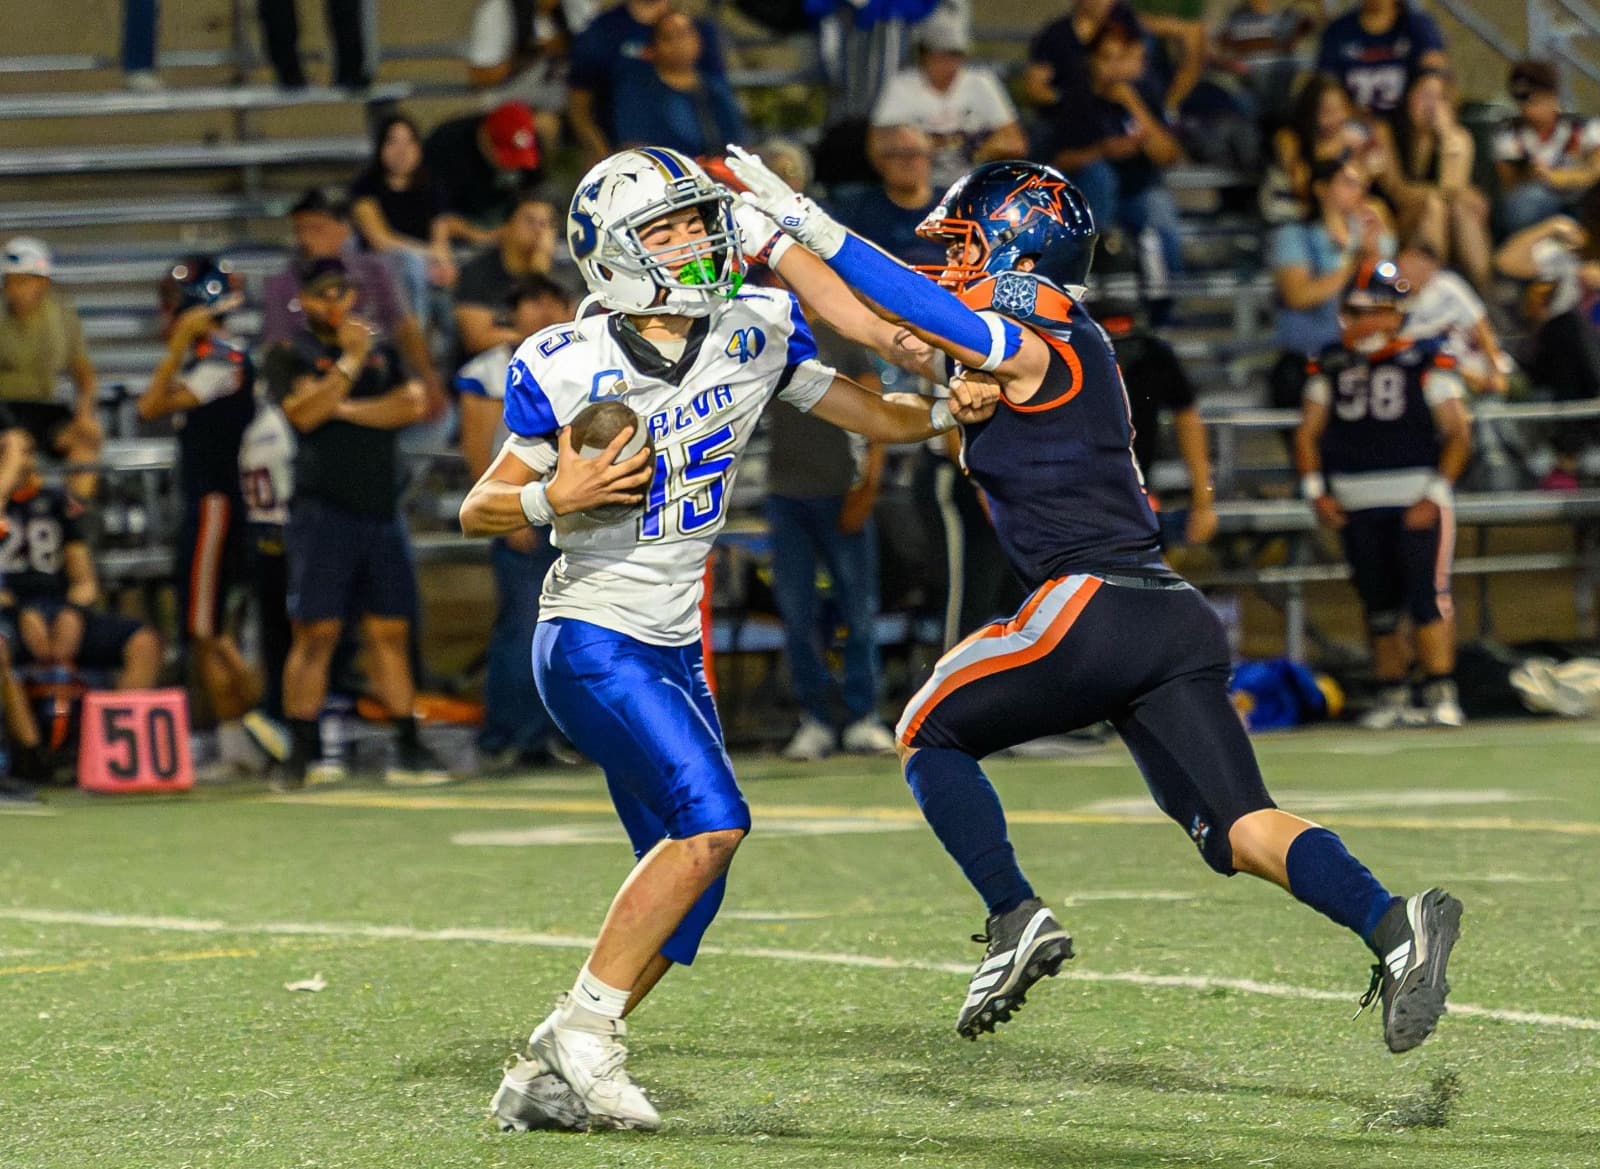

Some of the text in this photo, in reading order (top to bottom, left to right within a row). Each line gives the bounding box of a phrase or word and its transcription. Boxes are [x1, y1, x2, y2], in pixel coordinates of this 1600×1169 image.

[725, 326, 766, 364] 40
[646, 384, 734, 443] ALVA
[1335, 365, 1406, 421] 58
[637, 422, 736, 541] 15
[0, 515, 64, 575] 28
[102, 706, 179, 780] 50
